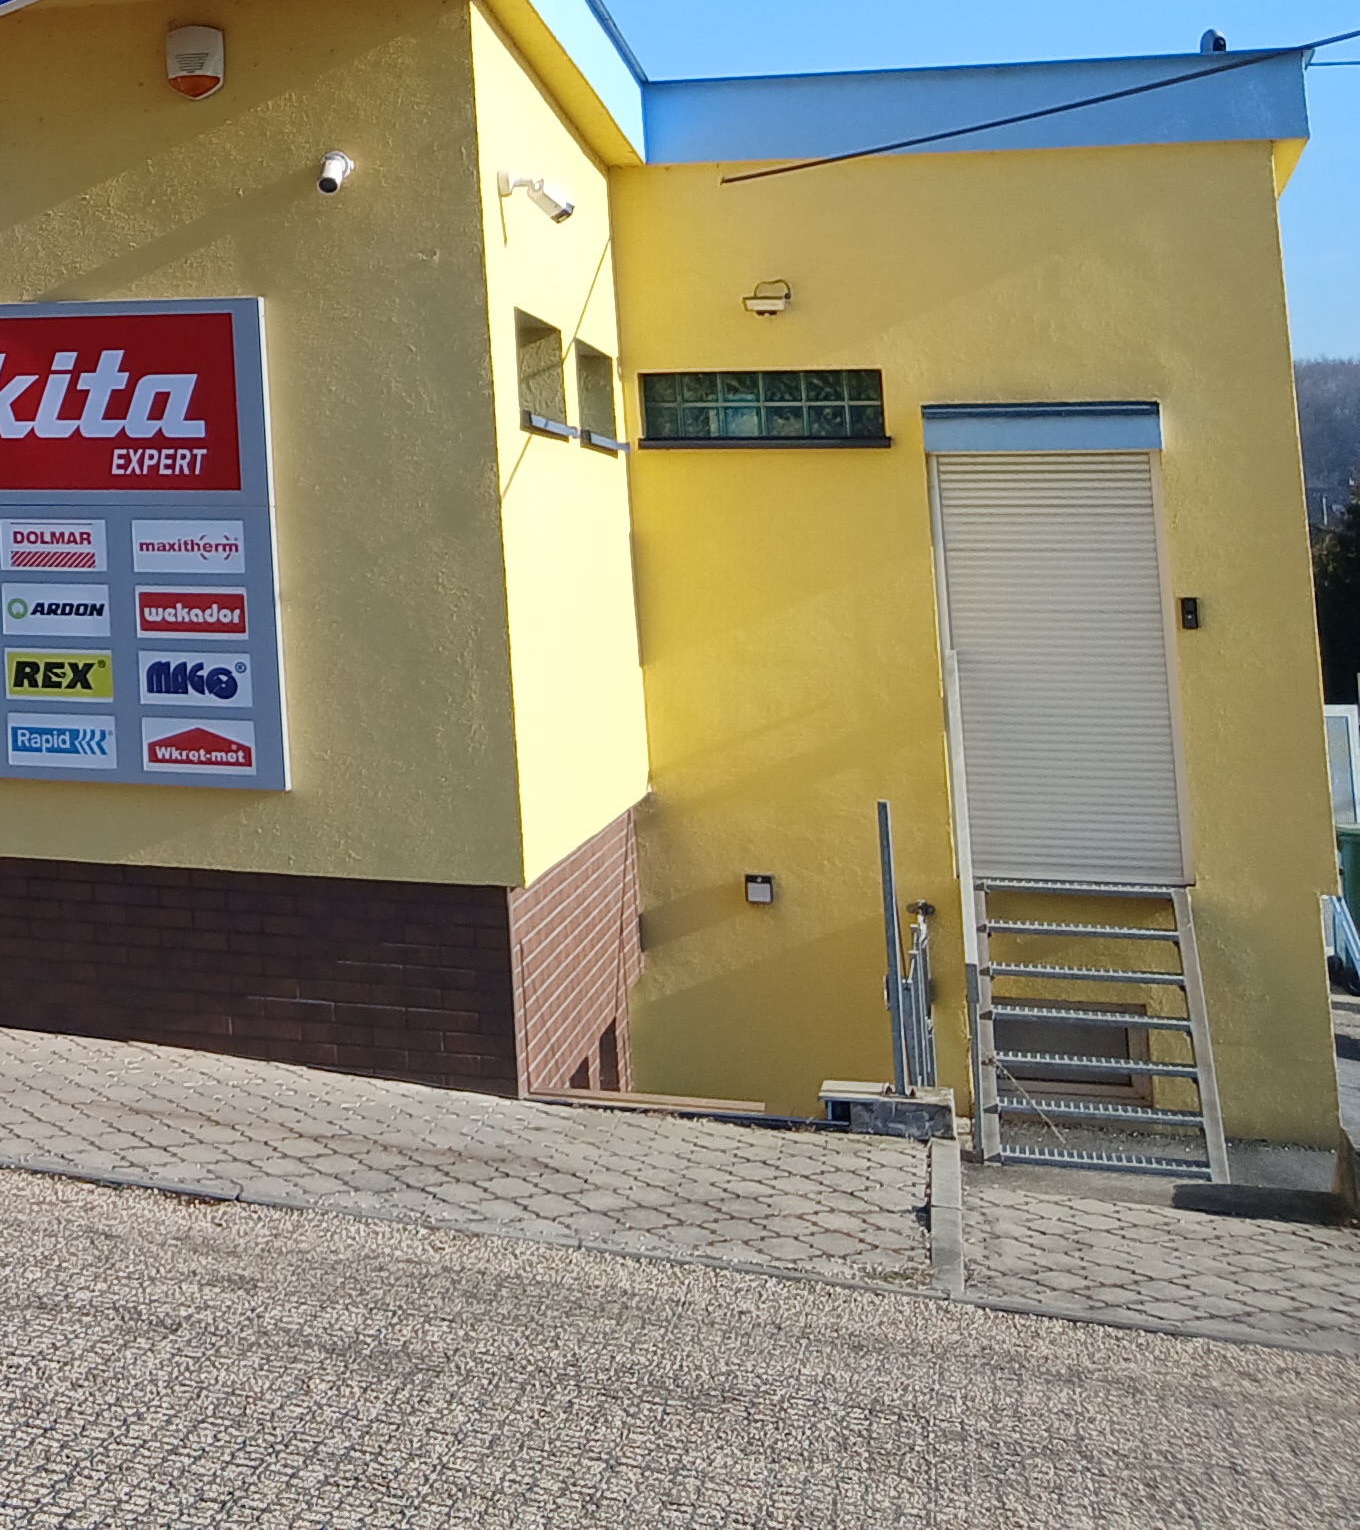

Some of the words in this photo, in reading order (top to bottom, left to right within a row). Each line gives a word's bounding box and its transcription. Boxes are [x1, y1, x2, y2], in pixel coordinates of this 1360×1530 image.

[111, 449, 207, 475] EXPERT
[13, 531, 92, 545] DOLMAR
[139, 538, 239, 553] maxitherm
[30, 603, 105, 617] ARDON
[143, 603, 240, 623] wekador
[13, 660, 96, 690] REX
[17, 729, 71, 754] Rapid
